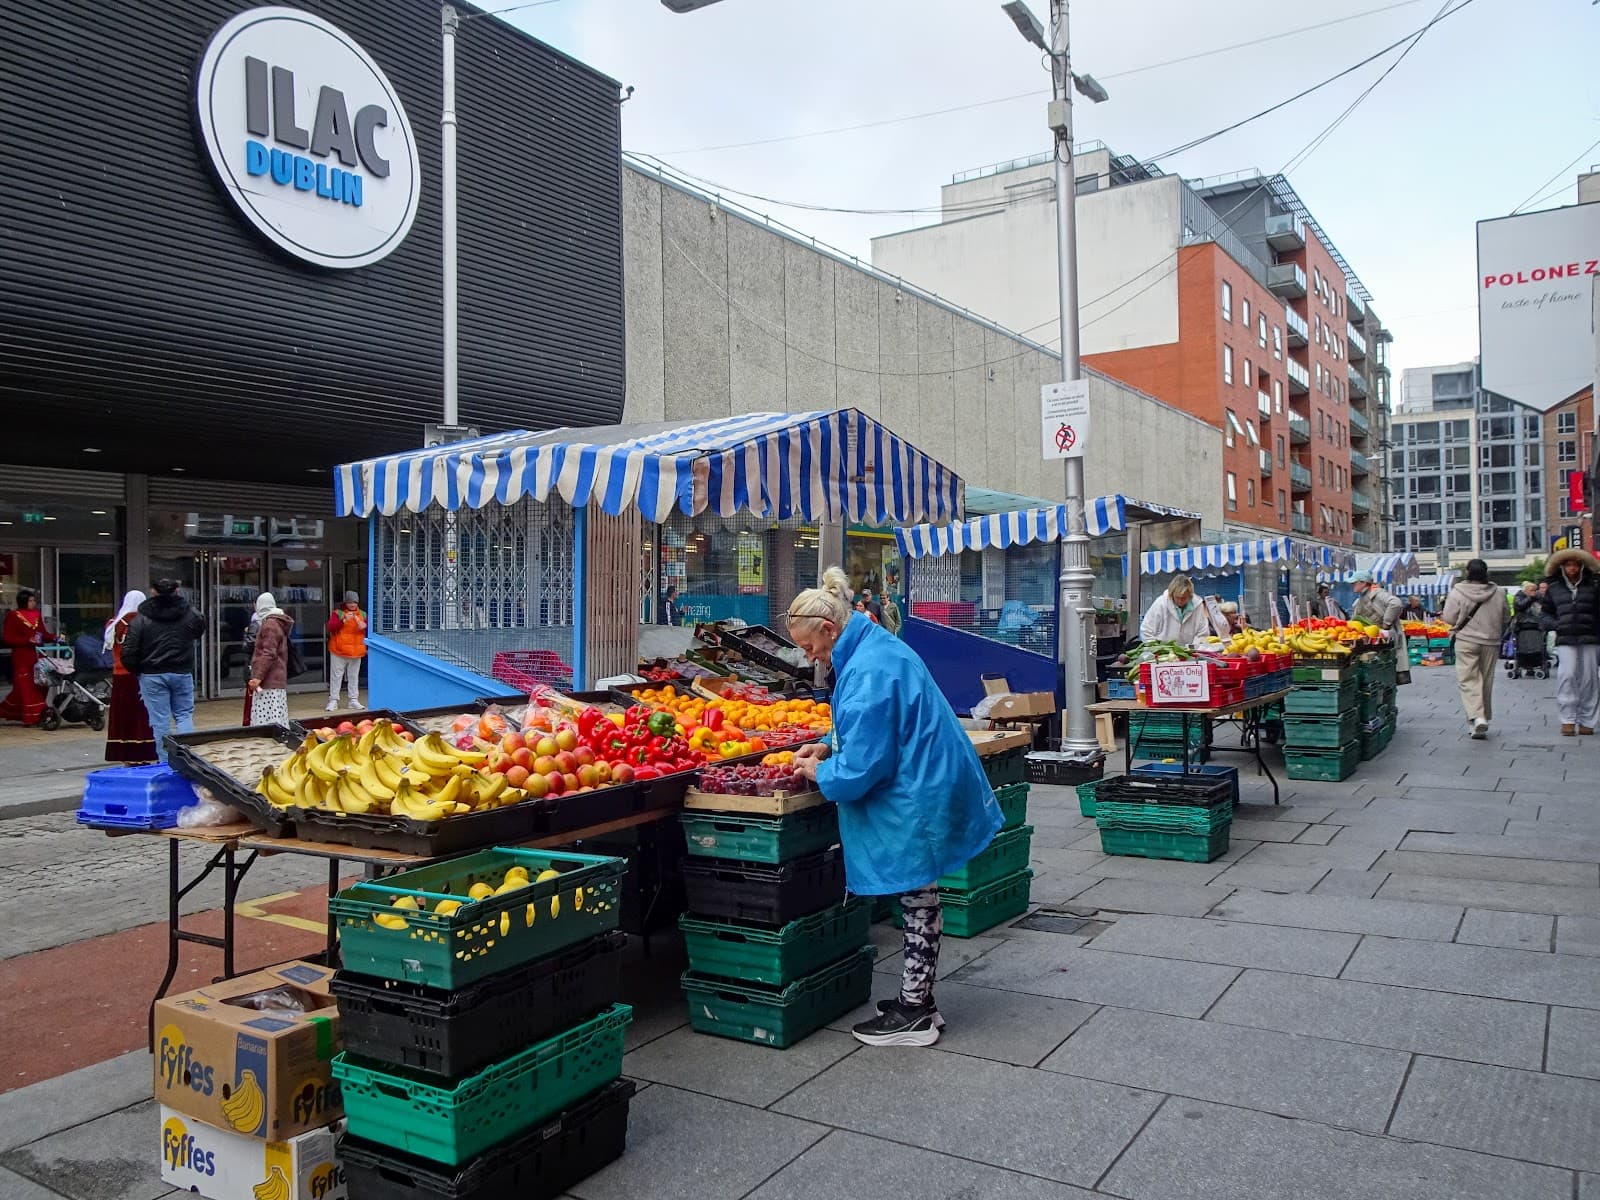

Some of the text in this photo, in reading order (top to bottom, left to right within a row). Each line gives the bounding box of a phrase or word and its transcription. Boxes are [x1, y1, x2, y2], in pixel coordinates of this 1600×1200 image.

[245, 55, 390, 178] ILAC
[246, 140, 362, 207] DUBLIN
[1484, 260, 1598, 289] POLONEZ
[1501, 291, 1582, 309] taste of home
[1169, 667, 1202, 677] Cash Only
[237, 1037, 267, 1056] Bananas
